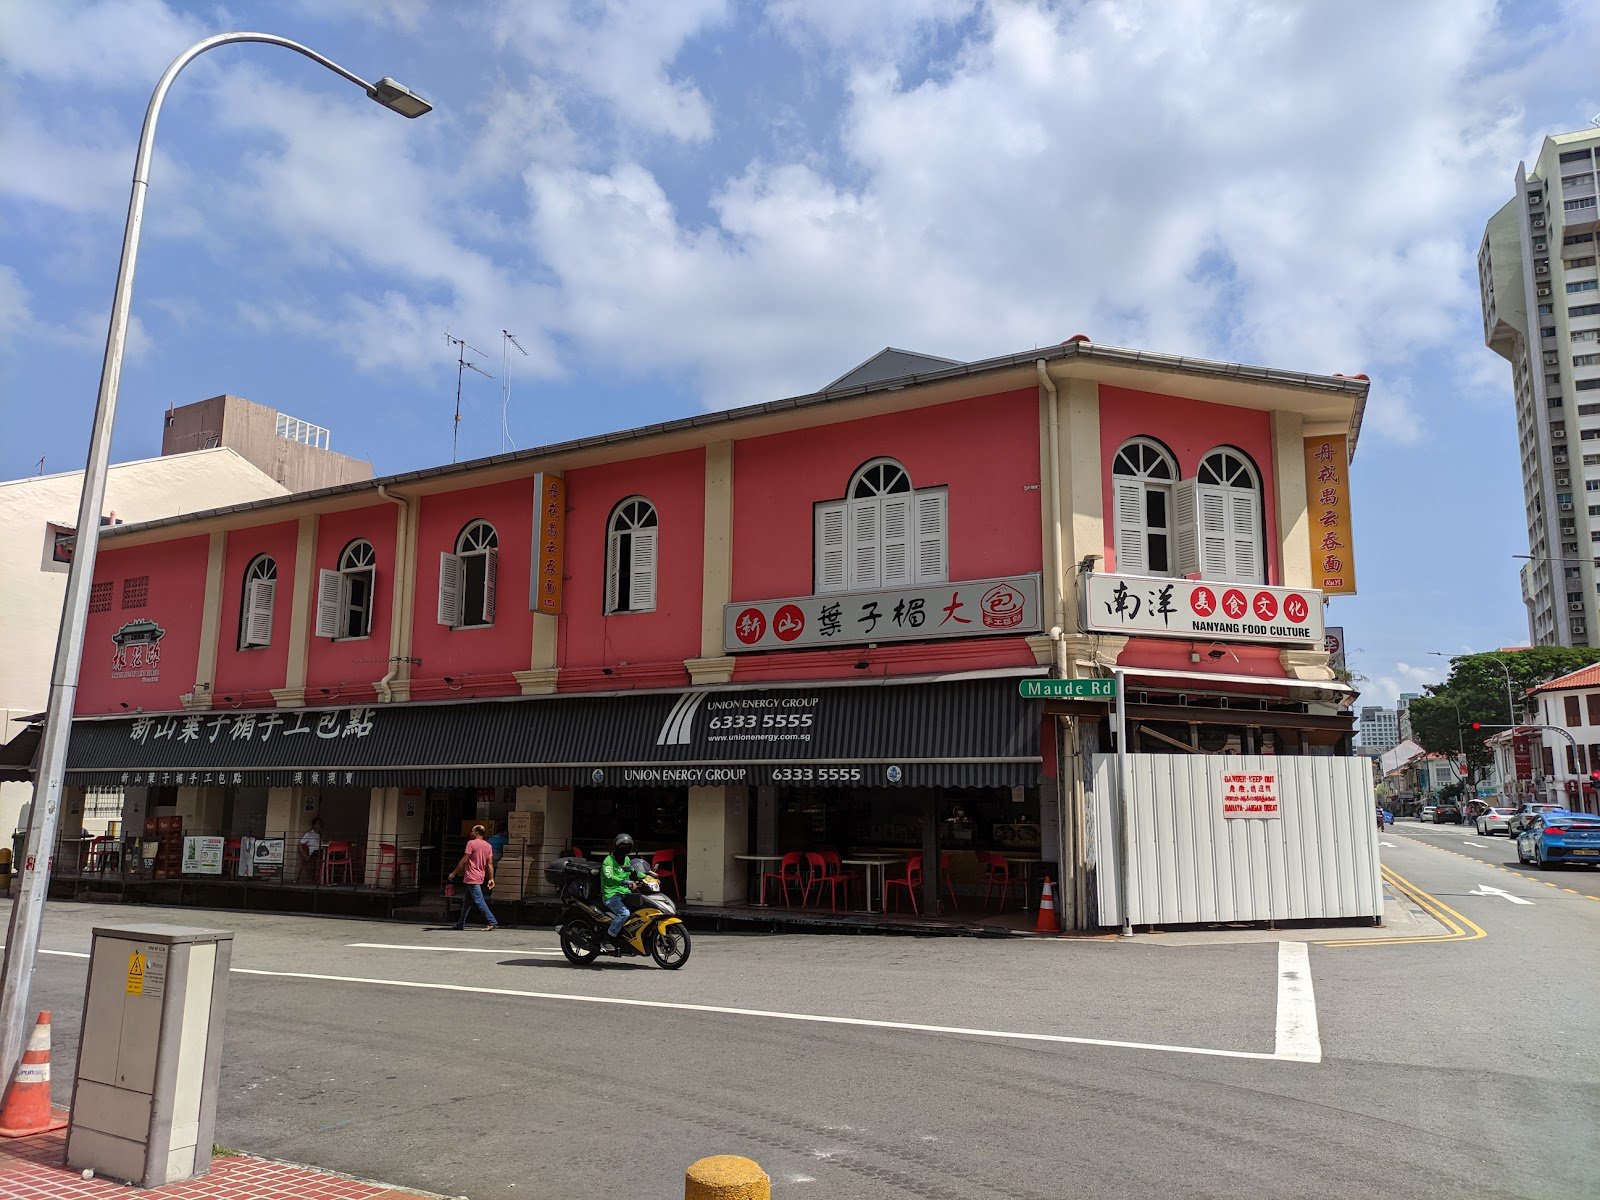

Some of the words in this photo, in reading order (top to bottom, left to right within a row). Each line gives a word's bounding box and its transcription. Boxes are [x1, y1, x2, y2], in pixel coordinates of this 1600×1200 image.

[1192, 620, 1240, 634] NANYANG
[1242, 624, 1267, 635] FOOD
[1269, 625, 1310, 638] CULTURE
[1028, 682, 1083, 695] Maude
[1091, 681, 1111, 695] Rd
[707, 700, 740, 711] UNION
[742, 699, 781, 708] ENERGY
[781, 697, 819, 707] GROUP
[709, 715, 757, 729] 6333
[762, 713, 813, 728] 5555
[708, 733, 811, 742] www.unionenergy.com.sg
[624, 769, 660, 781] UNION
[662, 769, 704, 781] ENERGY
[705, 768, 746, 781] GROUP
[772, 768, 813, 781] 6333
[818, 767, 861, 781] 5555
